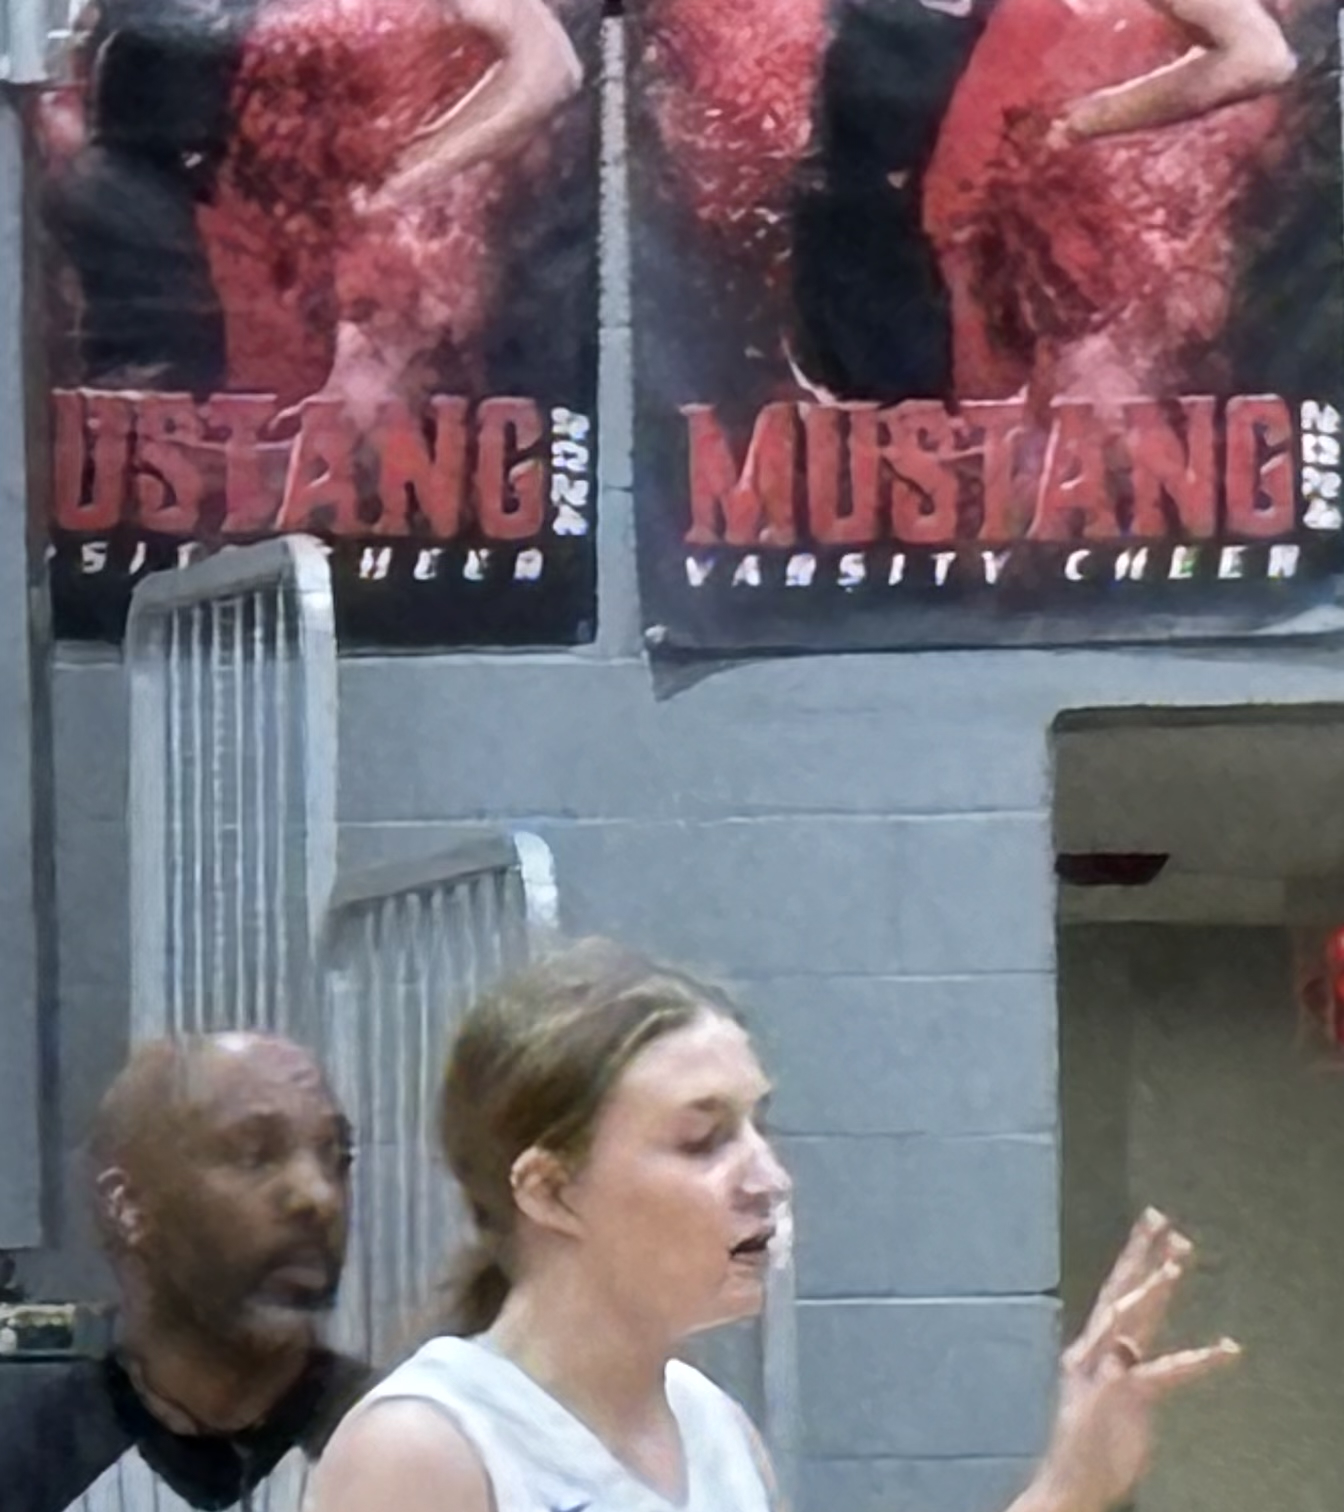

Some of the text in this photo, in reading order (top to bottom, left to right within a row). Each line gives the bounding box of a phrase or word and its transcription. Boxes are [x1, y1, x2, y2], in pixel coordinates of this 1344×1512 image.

[52, 387, 543, 540] USTANG
[680, 393, 1296, 544] MUSTANG
[359, 546, 544, 581] HEER
[685, 545, 1300, 588] VARSITY CHEER
